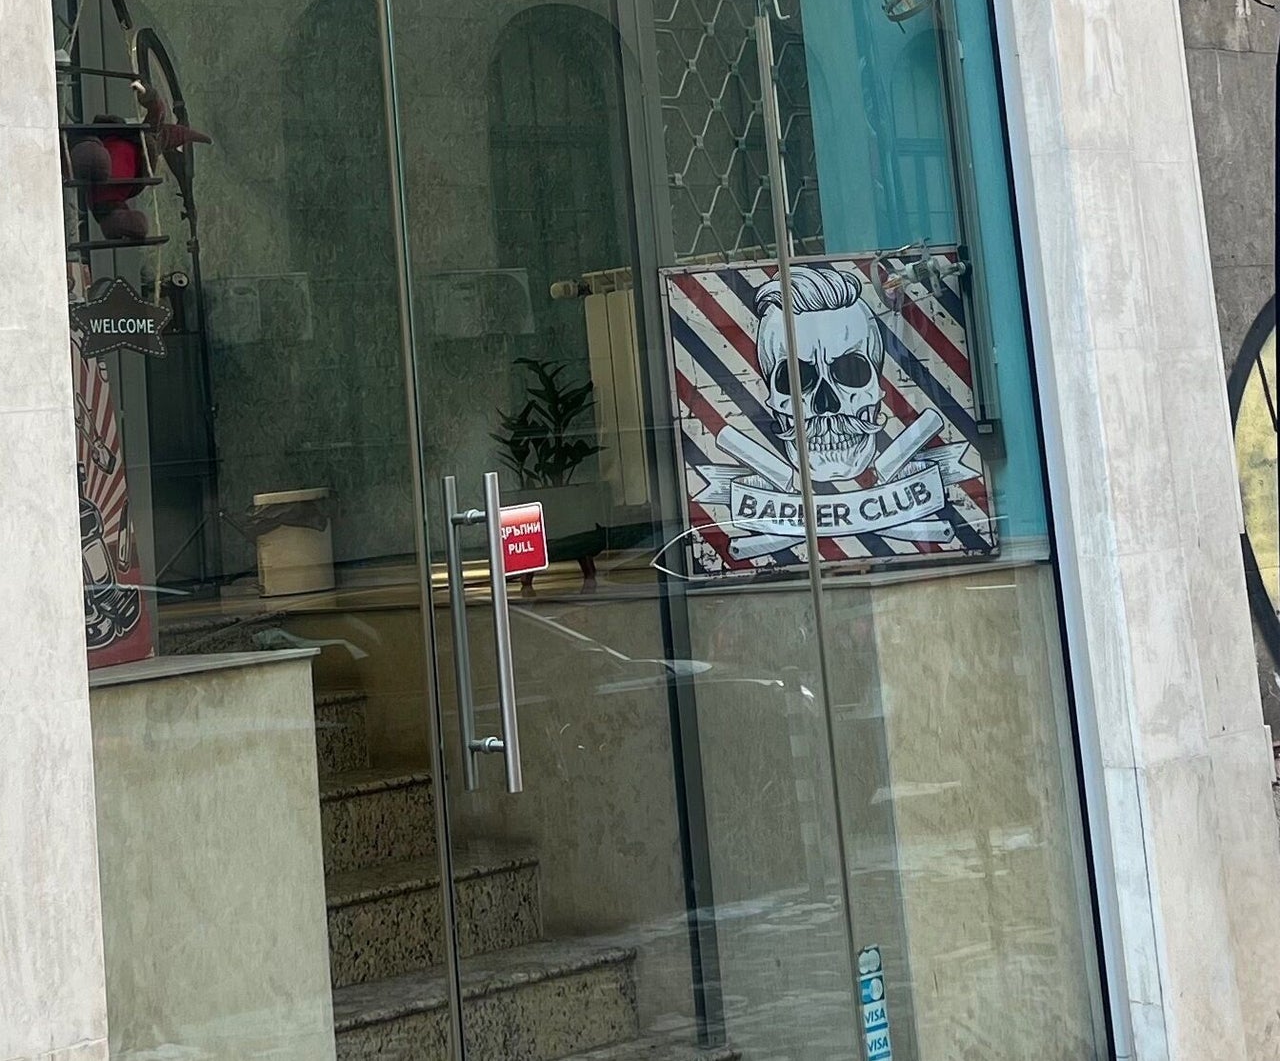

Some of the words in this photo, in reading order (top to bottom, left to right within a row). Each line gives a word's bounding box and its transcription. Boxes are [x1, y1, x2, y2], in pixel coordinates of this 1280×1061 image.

[89, 318, 156, 334] WELCOME
[858, 481, 933, 522] CLUB
[508, 540, 535, 555] PULL
[865, 1008, 886, 1024] VISA
[868, 1037, 889, 1052] VISA
